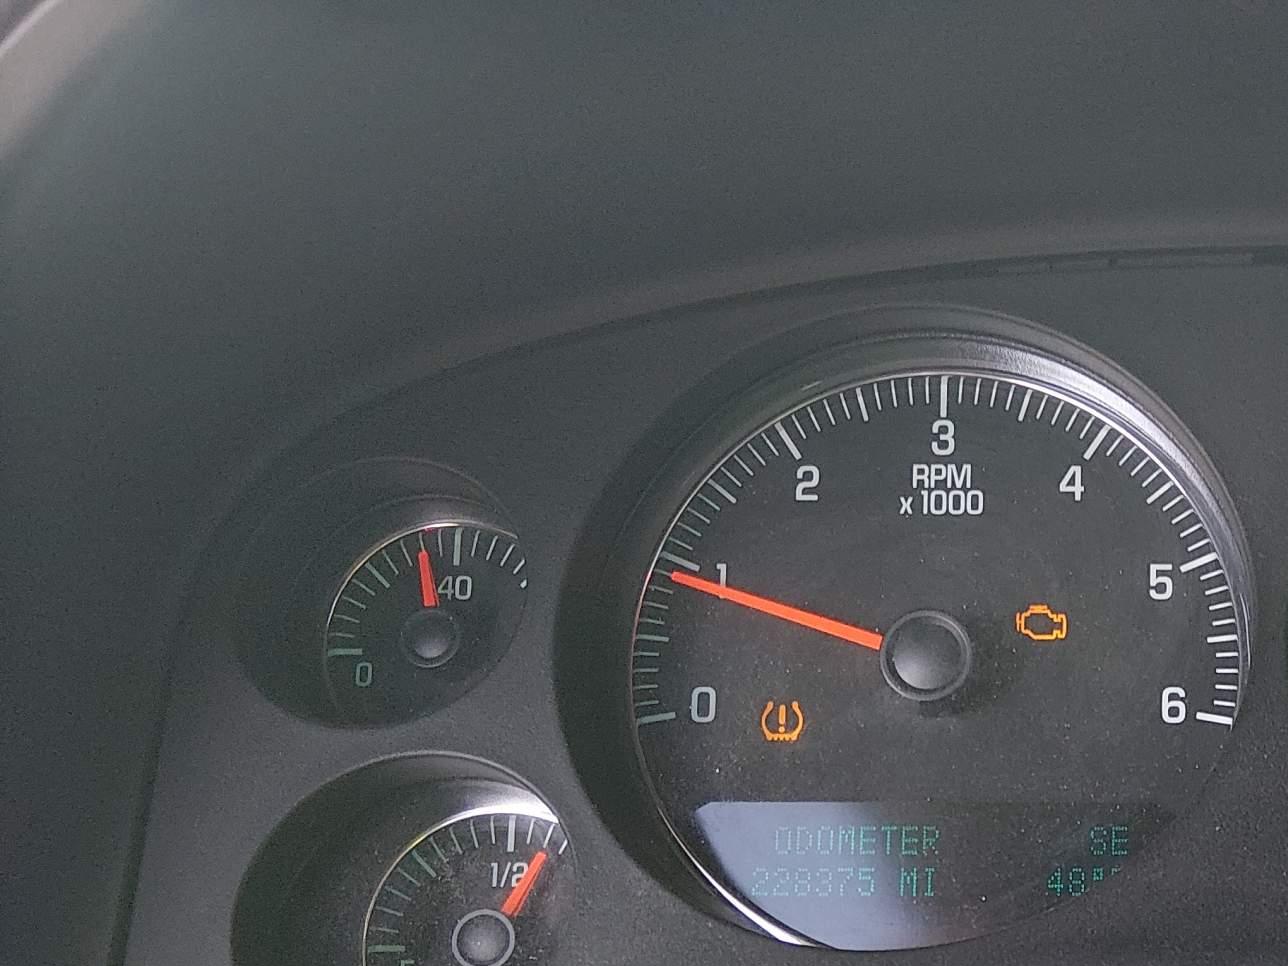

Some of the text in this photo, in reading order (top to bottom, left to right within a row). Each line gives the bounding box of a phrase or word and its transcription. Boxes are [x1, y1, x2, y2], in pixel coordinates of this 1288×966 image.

[931, 420, 955, 456] 3
[795, 467, 820, 501] 2
[912, 465, 972, 489] RPM
[1058, 466, 1085, 501] 4
[899, 490, 984, 516] x 1000
[438, 575, 473, 601] 40
[716, 563, 728, 599] 1
[1148, 565, 1173, 600] 5
[355, 662, 373, 688] 0
[691, 687, 716, 723] 0
[1161, 688, 1186, 724] 6
[775, 826, 1128, 856] ODOMETER SE
[490, 862, 530, 888] 1/2
[752, 868, 875, 897] 228375
[900, 867, 935, 897] MI
